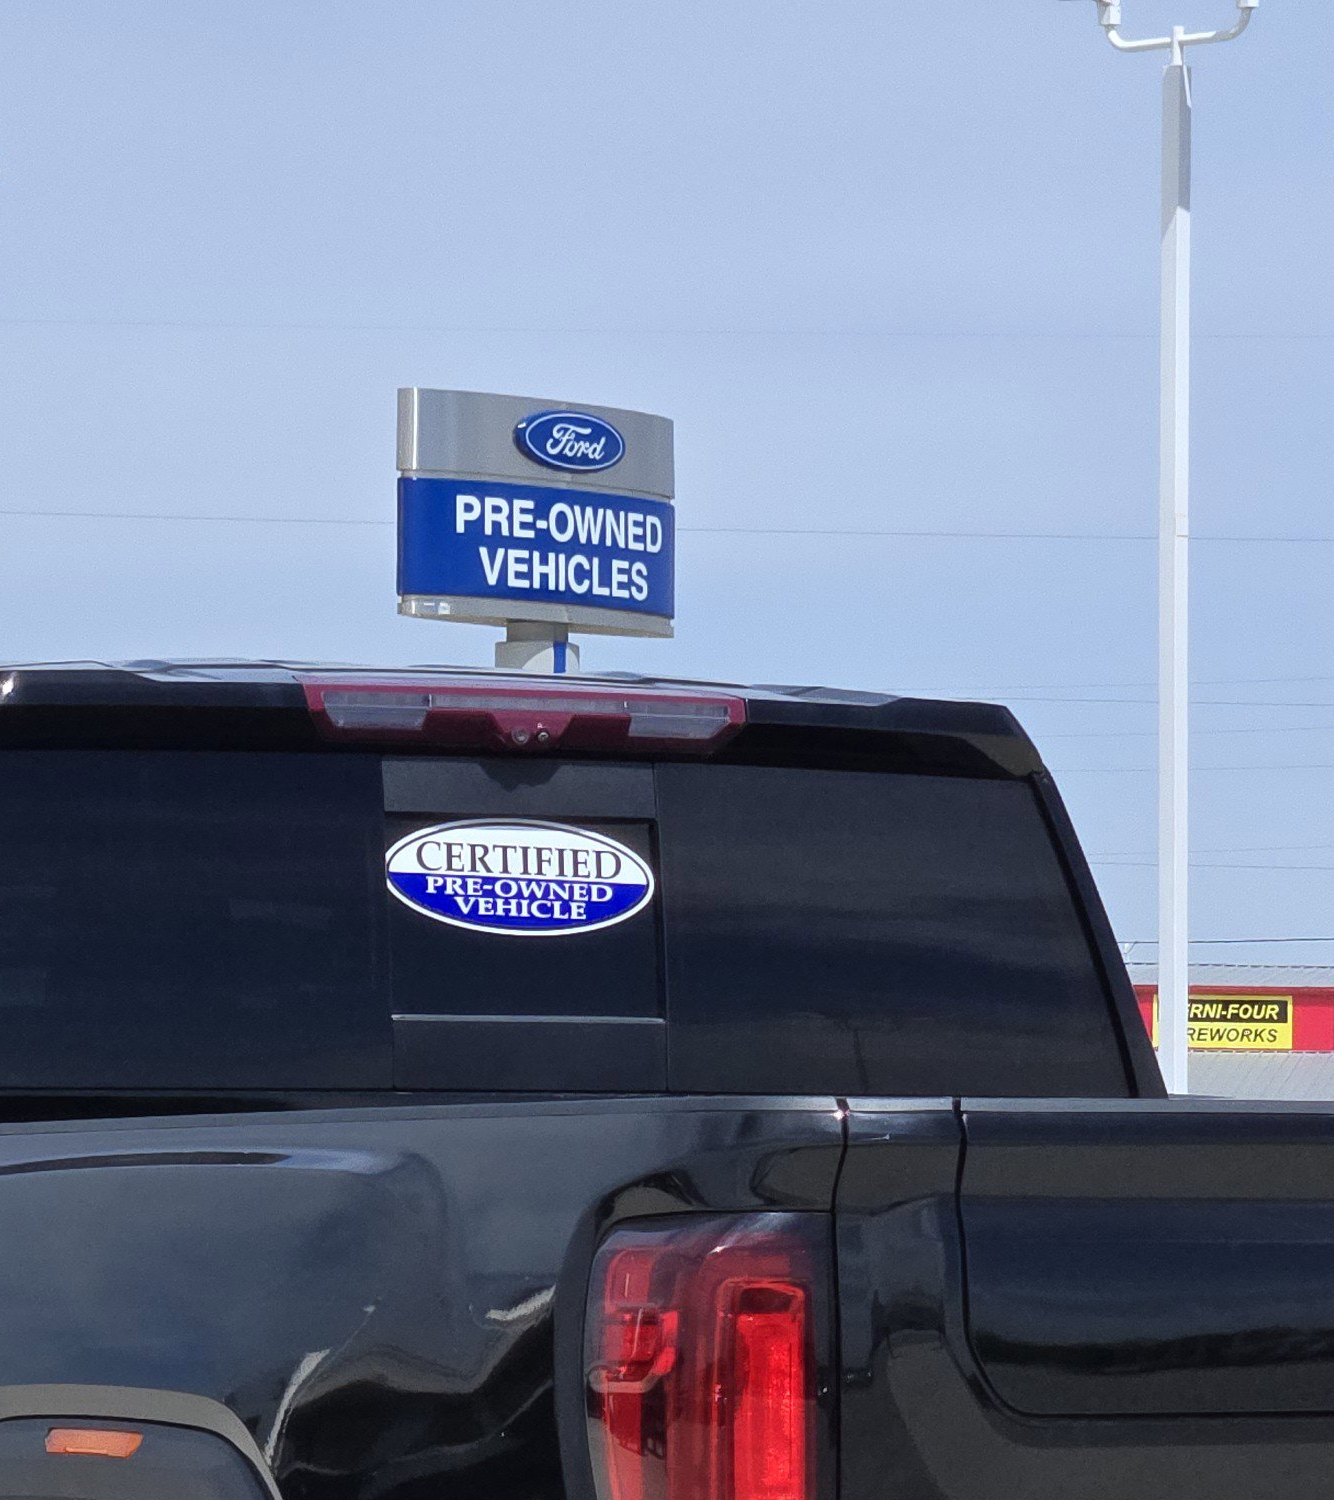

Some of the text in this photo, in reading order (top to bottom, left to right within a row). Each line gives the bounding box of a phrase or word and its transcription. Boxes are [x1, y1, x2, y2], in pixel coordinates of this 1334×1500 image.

[546, 422, 606, 460] Ford
[455, 494, 663, 553] PRE-OWNED
[478, 546, 648, 601] VEHICLES
[416, 840, 622, 879] CERTIFIED
[425, 875, 613, 902] PRE-OWNED
[453, 896, 587, 920] VEHICLE
[1188, 1003, 1279, 1020] RNI-FOUR
[1187, 1027, 1278, 1042] REWORKS
